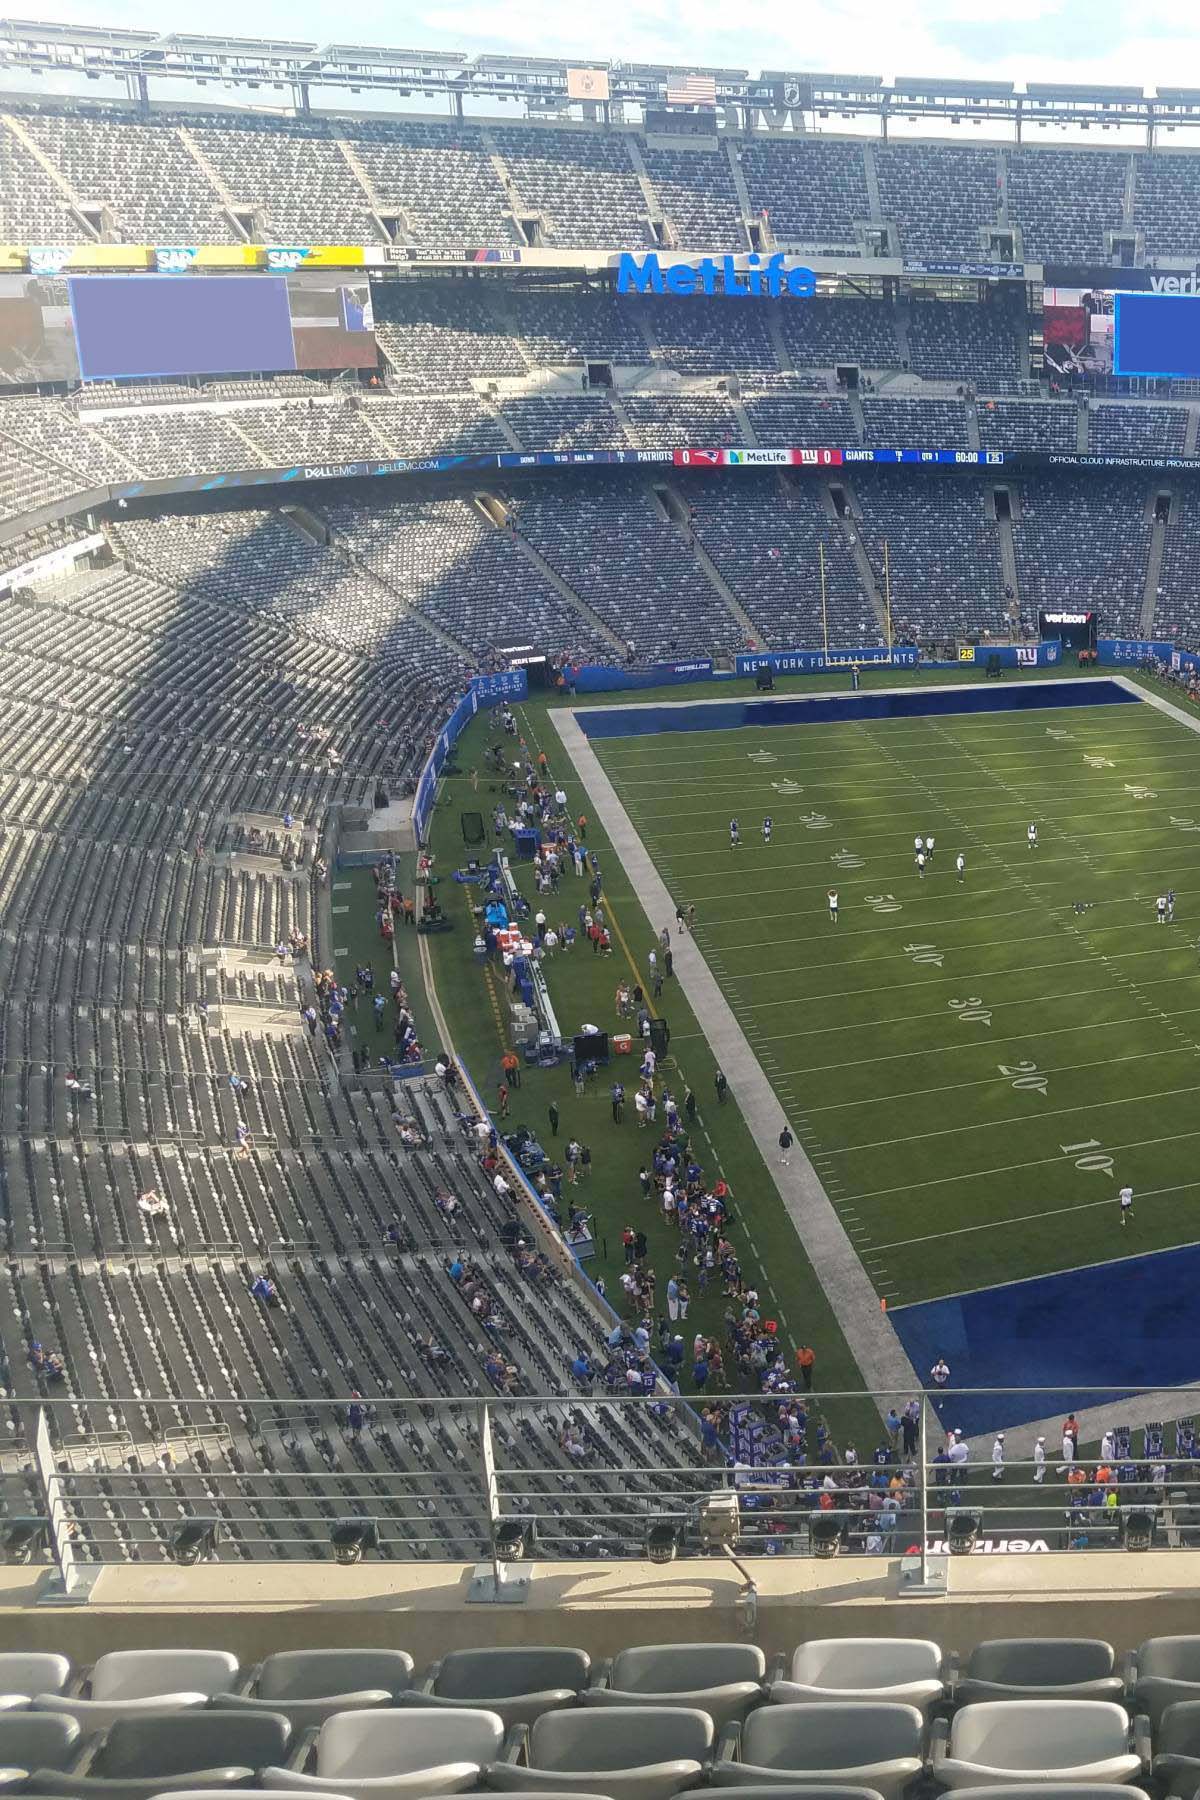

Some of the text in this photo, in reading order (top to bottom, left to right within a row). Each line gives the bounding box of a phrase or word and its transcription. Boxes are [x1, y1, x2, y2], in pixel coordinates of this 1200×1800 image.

[30, 250, 70, 271] SAP
[157, 250, 196, 269] SAP
[267, 250, 304, 269] SAP
[617, 252, 816, 297] MetLife
[637, 451, 673, 462] PATRIOTS
[682, 451, 690, 463] 0
[747, 452, 786, 462] MetLife
[824, 451, 831, 463] 0
[845, 451, 874, 461] GIANTS
[955, 452, 978, 463] 60:00
[1049, 456, 1079, 464] OFFICIAL
[1080, 457, 1104, 465] CLOUD
[1105, 457, 1165, 467] INFRASTRUCTURE
[1166, 460, 1200, 468] PROVIDER
[378, 460, 439, 473] DELLEMC.COM
[1045, 612, 1087, 623] verizon
[743, 653, 915, 672] NEW YORK FOOTBALL GIANTS
[961, 649, 973, 660] 25
[864, 894, 903, 913] 50
[903, 943, 945, 963] 40
[947, 997, 993, 1021] 30
[997, 1061, 1048, 1089] 20
[1059, 1138, 1114, 1170] 10
